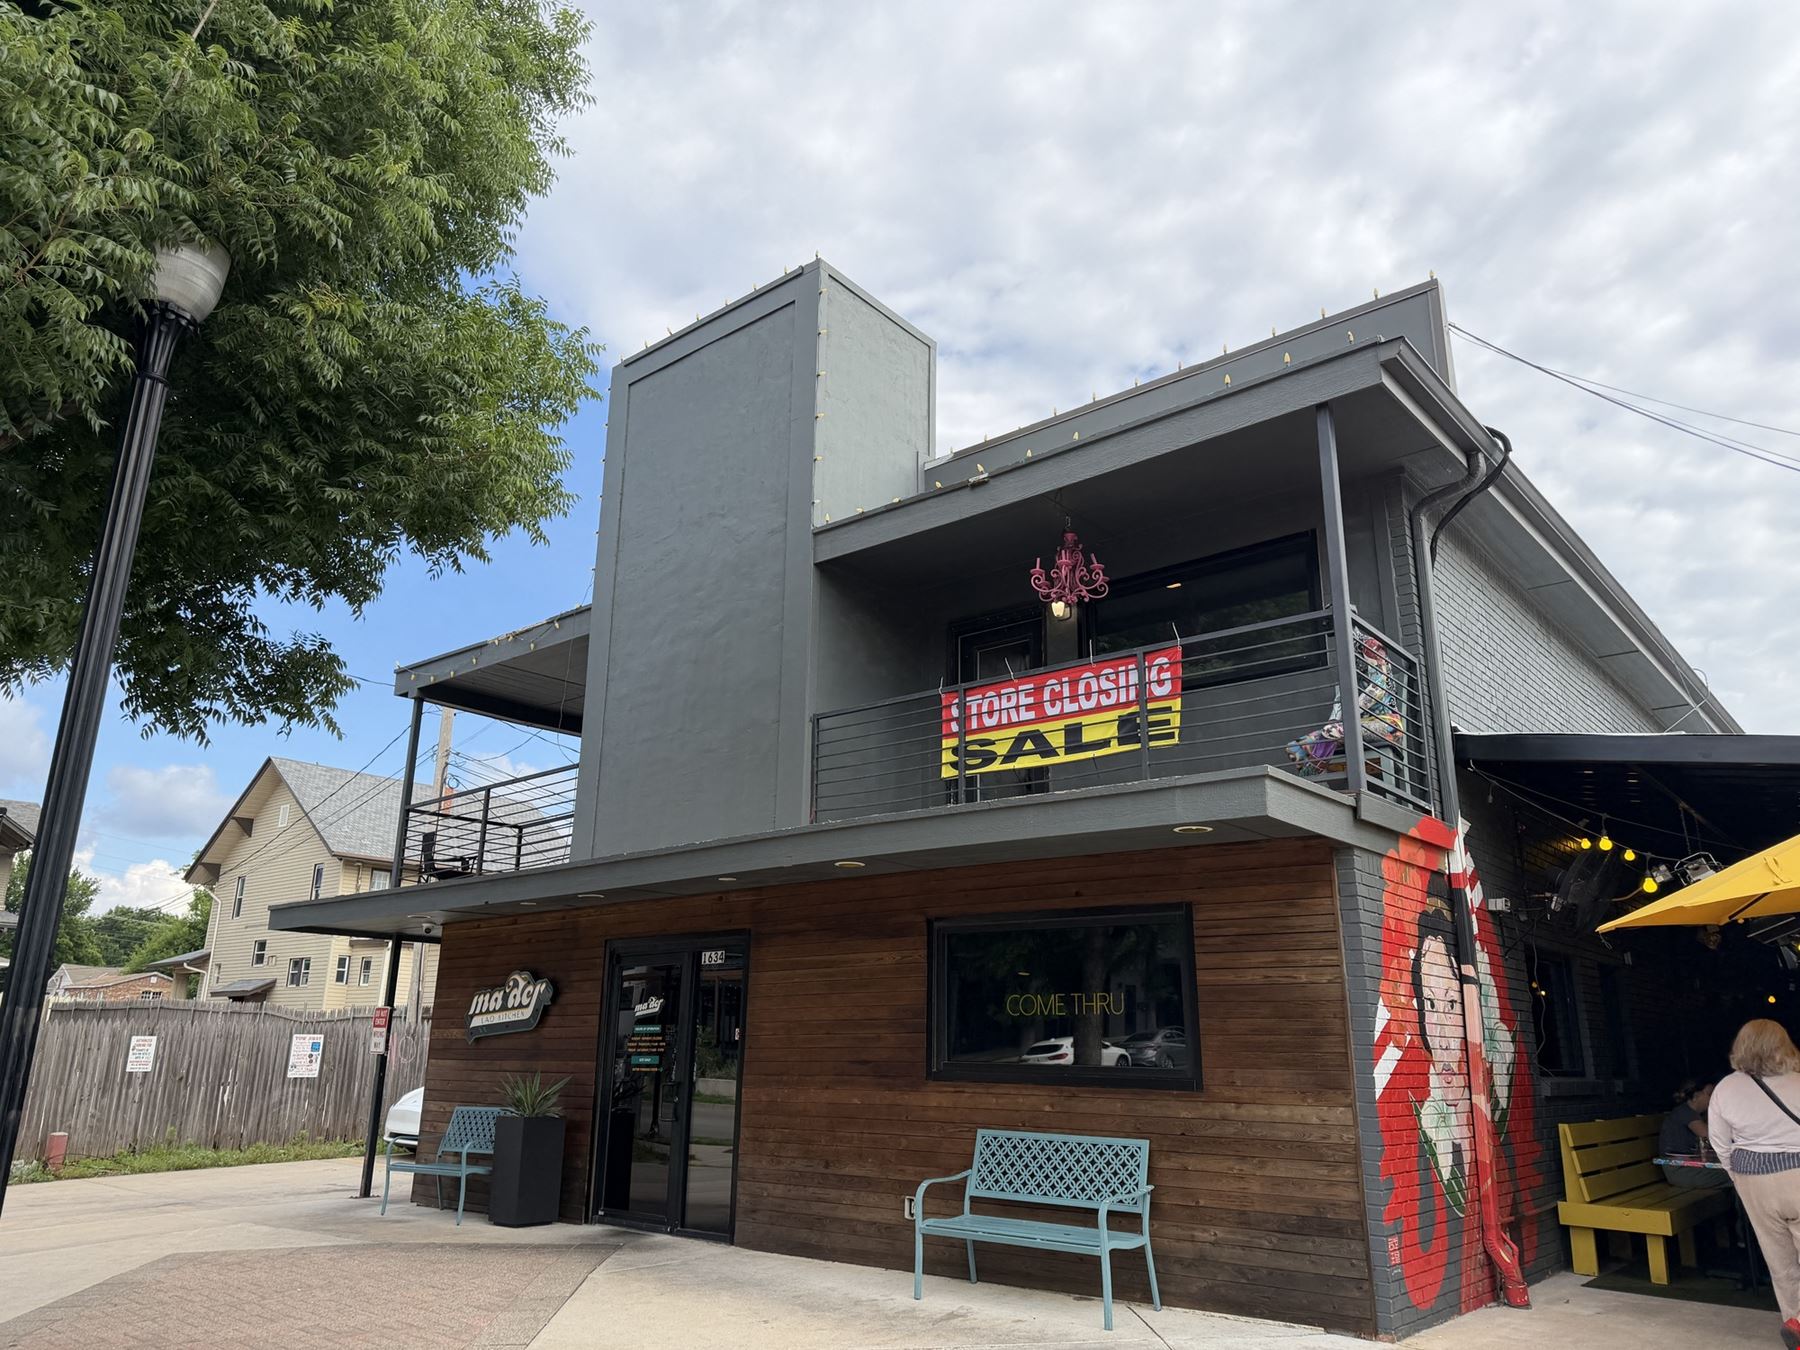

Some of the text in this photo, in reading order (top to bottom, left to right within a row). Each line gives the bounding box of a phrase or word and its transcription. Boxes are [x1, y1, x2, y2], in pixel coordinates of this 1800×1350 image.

[1043, 656, 1173, 716] CLOSING
[950, 705, 1176, 771] SALE
[703, 951, 724, 964] 1634
[1006, 992, 1126, 1017] COME THRU
